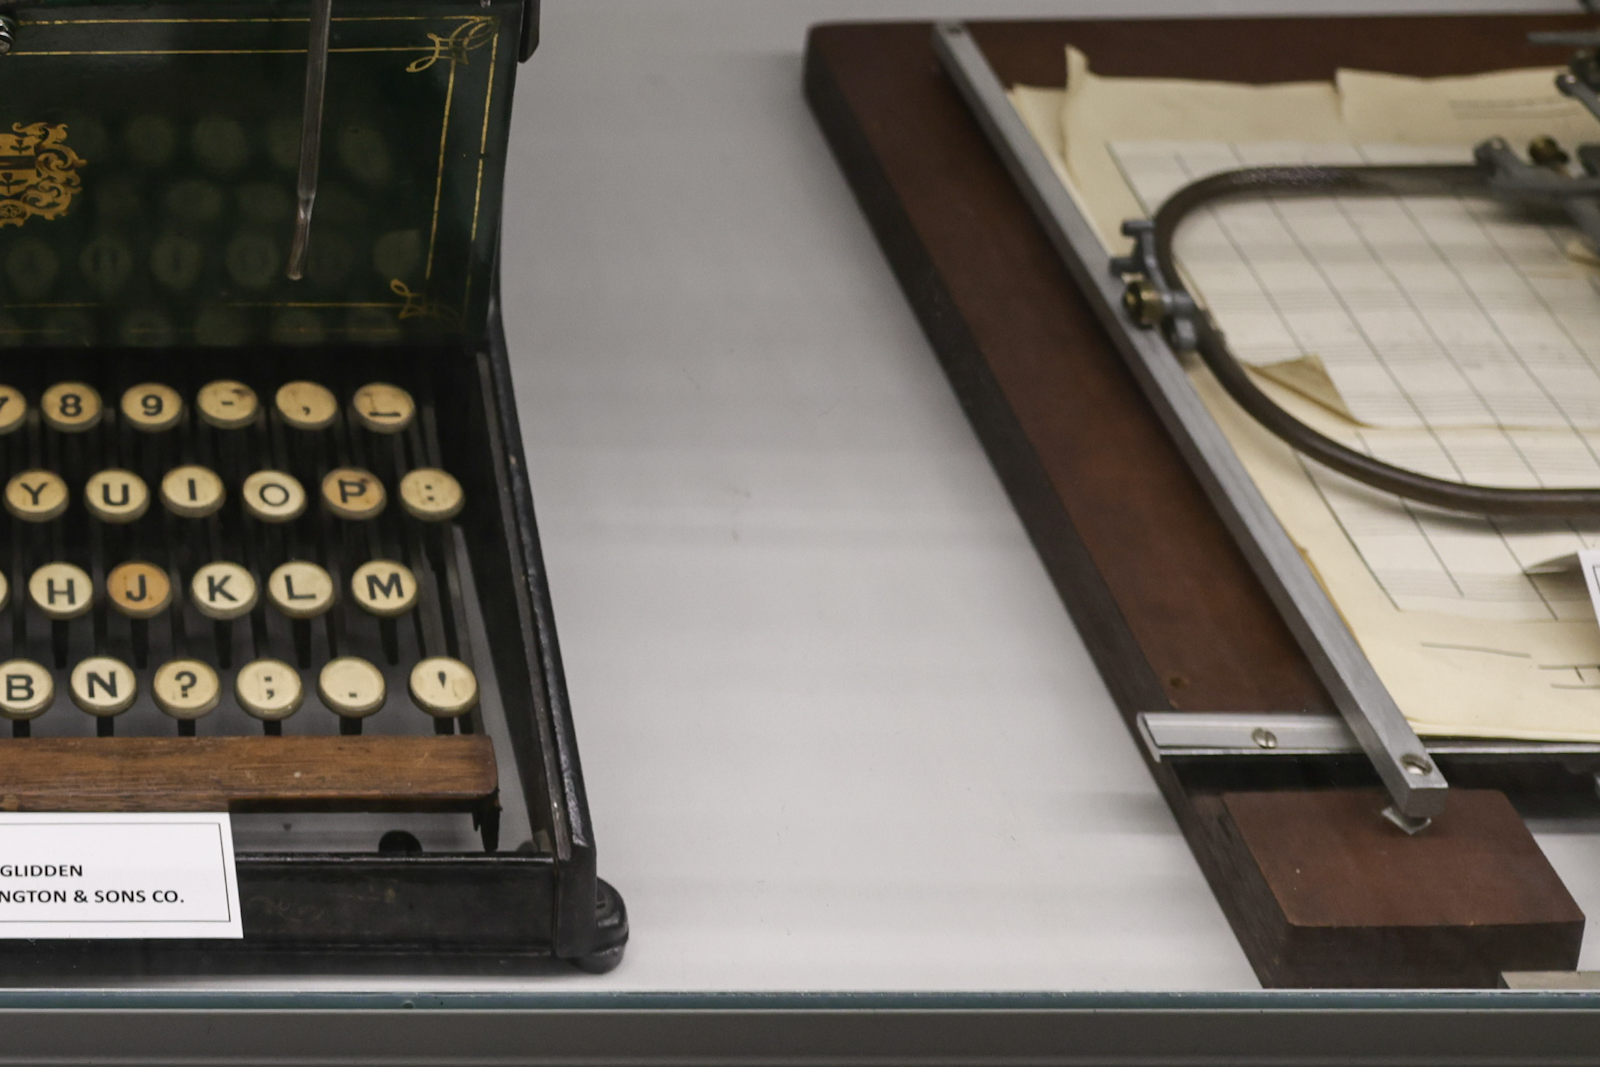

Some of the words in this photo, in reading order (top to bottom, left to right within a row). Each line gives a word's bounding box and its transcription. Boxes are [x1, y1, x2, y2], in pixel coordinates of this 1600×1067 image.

[58, 392, 84, 418] 8
[140, 393, 164, 418] 9
[19, 481, 49, 507] Y
[101, 482, 131, 508] U
[186, 477, 198, 502] I
[257, 482, 291, 508] O
[336, 477, 370, 505] P
[45, 577, 77, 606] H
[124, 573, 148, 603] J
[206, 574, 239, 603] K
[283, 573, 318, 602] L
[365, 571, 405, 602] M
[5, 672, 36, 703] B
[85, 670, 119, 700] N
[173, 669, 199, 699] ?
[72, 889, 89, 904] &
[93, 889, 147, 904] SONS
[151, 889, 185, 904] CO.
